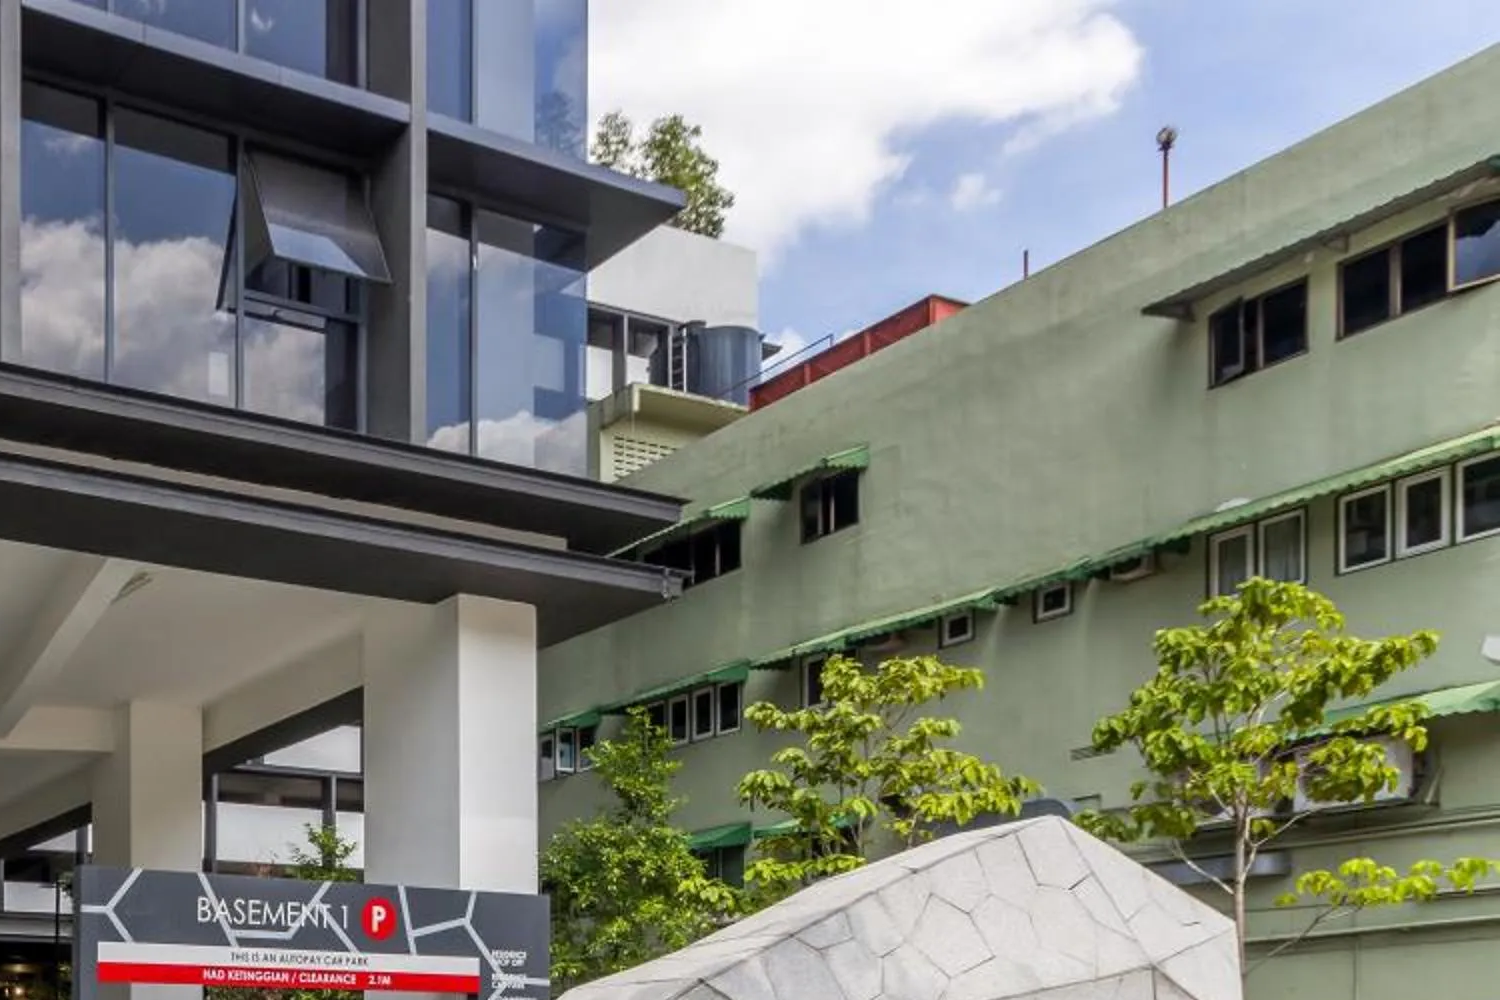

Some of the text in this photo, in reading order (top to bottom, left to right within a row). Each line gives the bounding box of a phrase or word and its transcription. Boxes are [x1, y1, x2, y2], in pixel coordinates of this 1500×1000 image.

[197, 895, 387, 933] BASEMENT 1 P
[231, 952, 369, 967] THIS IS AN AUTOPAY CAR PARK
[299, 972, 357, 986] CLEARANCE
